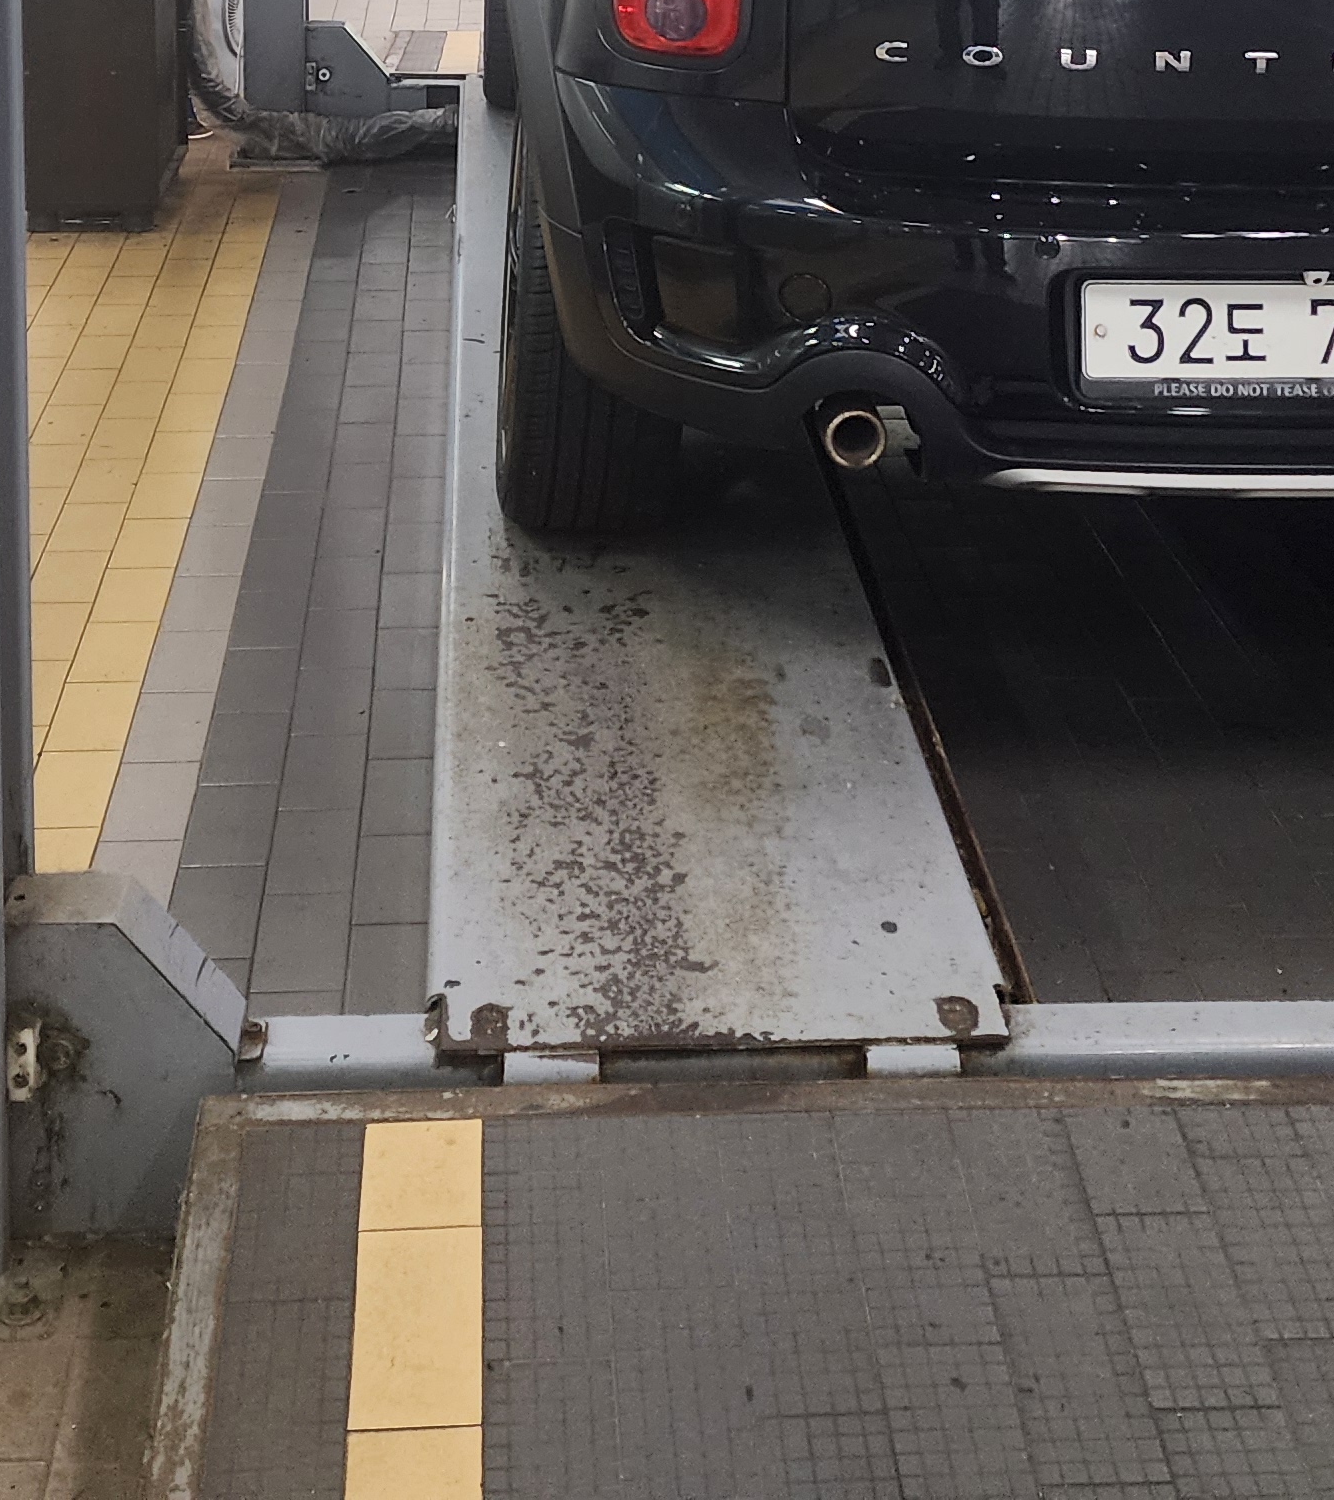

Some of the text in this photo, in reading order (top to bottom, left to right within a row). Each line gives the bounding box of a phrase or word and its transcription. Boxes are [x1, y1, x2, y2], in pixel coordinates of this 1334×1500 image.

[1127, 298, 1267, 365] 32도
[1154, 383, 1207, 398] PLEASE
[1210, 383, 1234, 398] DO
[1238, 383, 1270, 398] NOT
[1275, 383, 1319, 398] TEASE
